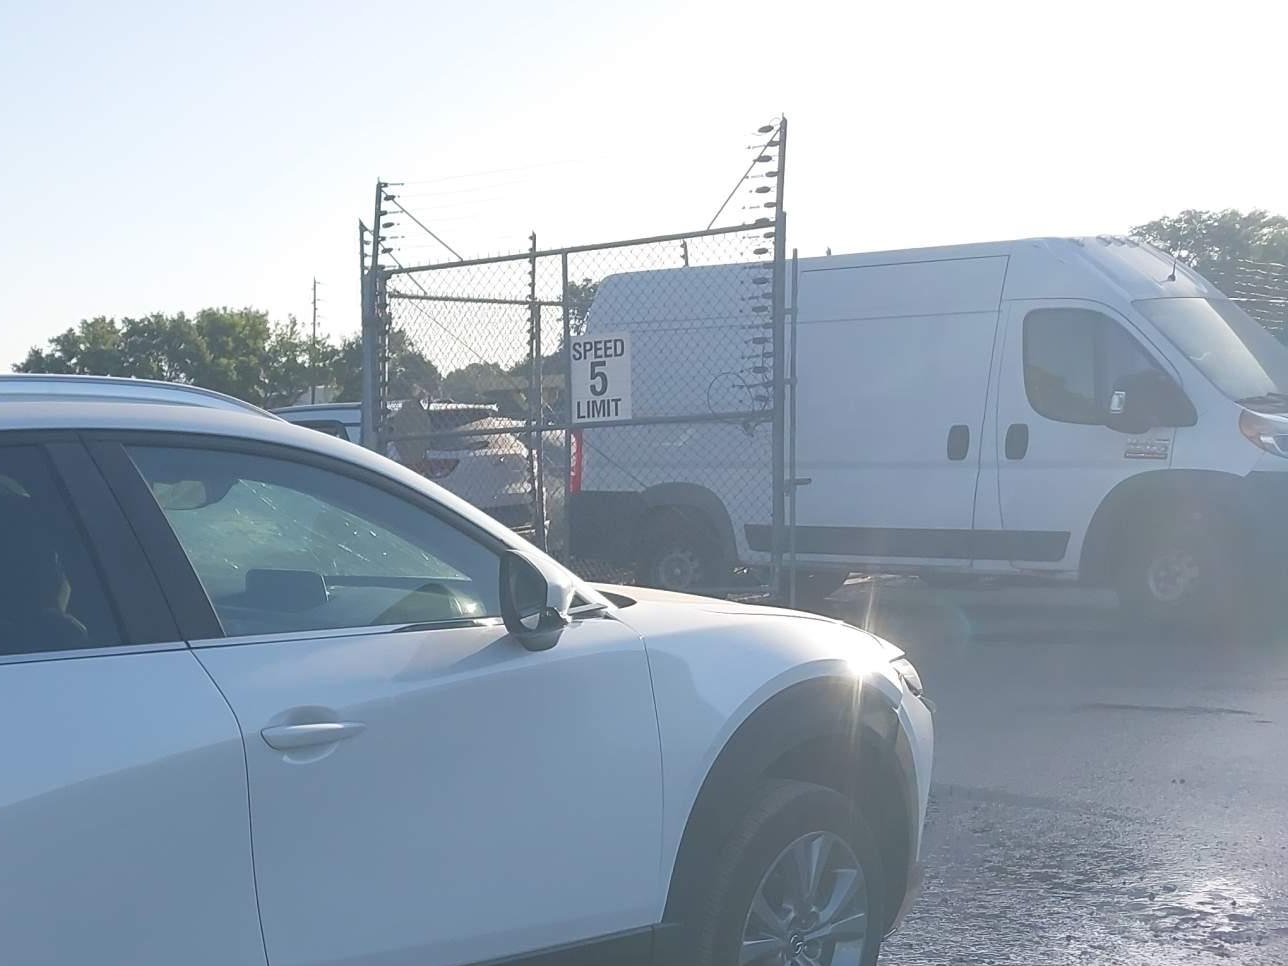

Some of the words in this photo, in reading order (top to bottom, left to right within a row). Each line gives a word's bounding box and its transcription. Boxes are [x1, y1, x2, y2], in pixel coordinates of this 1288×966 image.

[572, 339, 625, 361] SPEED
[590, 361, 608, 397] 5
[576, 398, 622, 419] LIMIT
